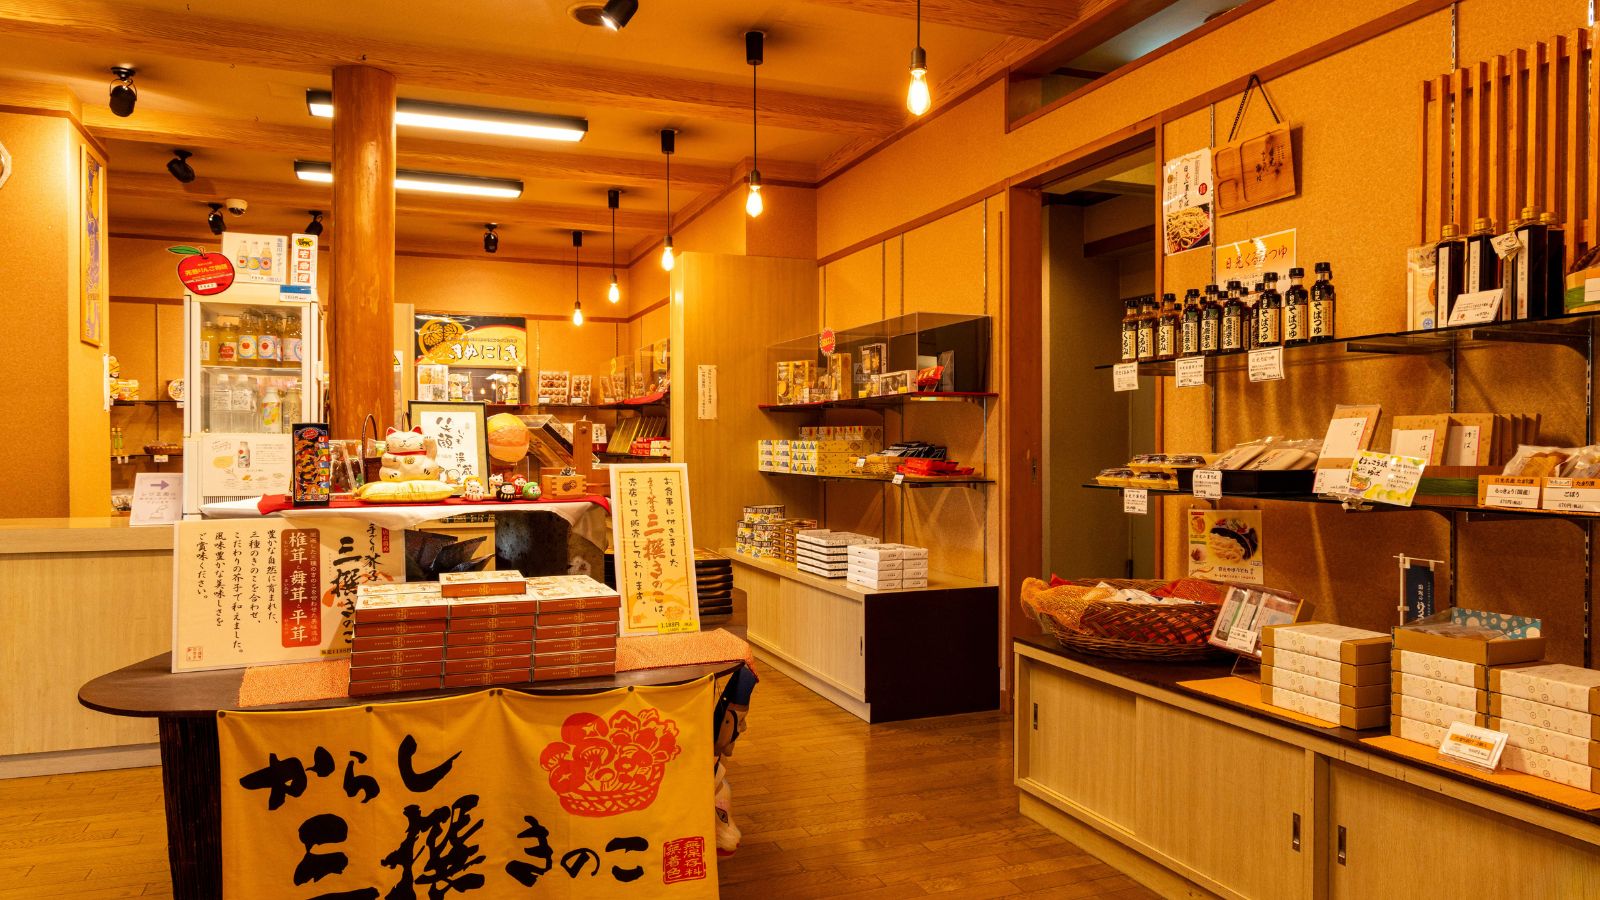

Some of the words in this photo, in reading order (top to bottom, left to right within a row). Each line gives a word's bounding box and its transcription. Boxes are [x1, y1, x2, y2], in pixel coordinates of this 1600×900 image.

[298, 249, 310, 283] 宅急便
[436, 416, 454, 449] 笑顔
[196, 533, 209, 600] ご賞味ください。
[628, 477, 646, 605] 売店にて販売しております。
[663, 477, 678, 568] お食事に付きました
[214, 532, 226, 628] 風味豊かな美味しさを
[231, 531, 245, 654] こだわりの芥子で和えました。
[249, 530, 262, 624] 三種のきのこを合わせ、
[266, 528, 279, 625] 豊かな自然に育まれた、
[289, 532, 308, 643] 椎茸と舞茸と平茸
[239, 734, 463, 811] からし
[665, 843, 682, 880] 無着色
[683, 840, 703, 877] 無保存料
